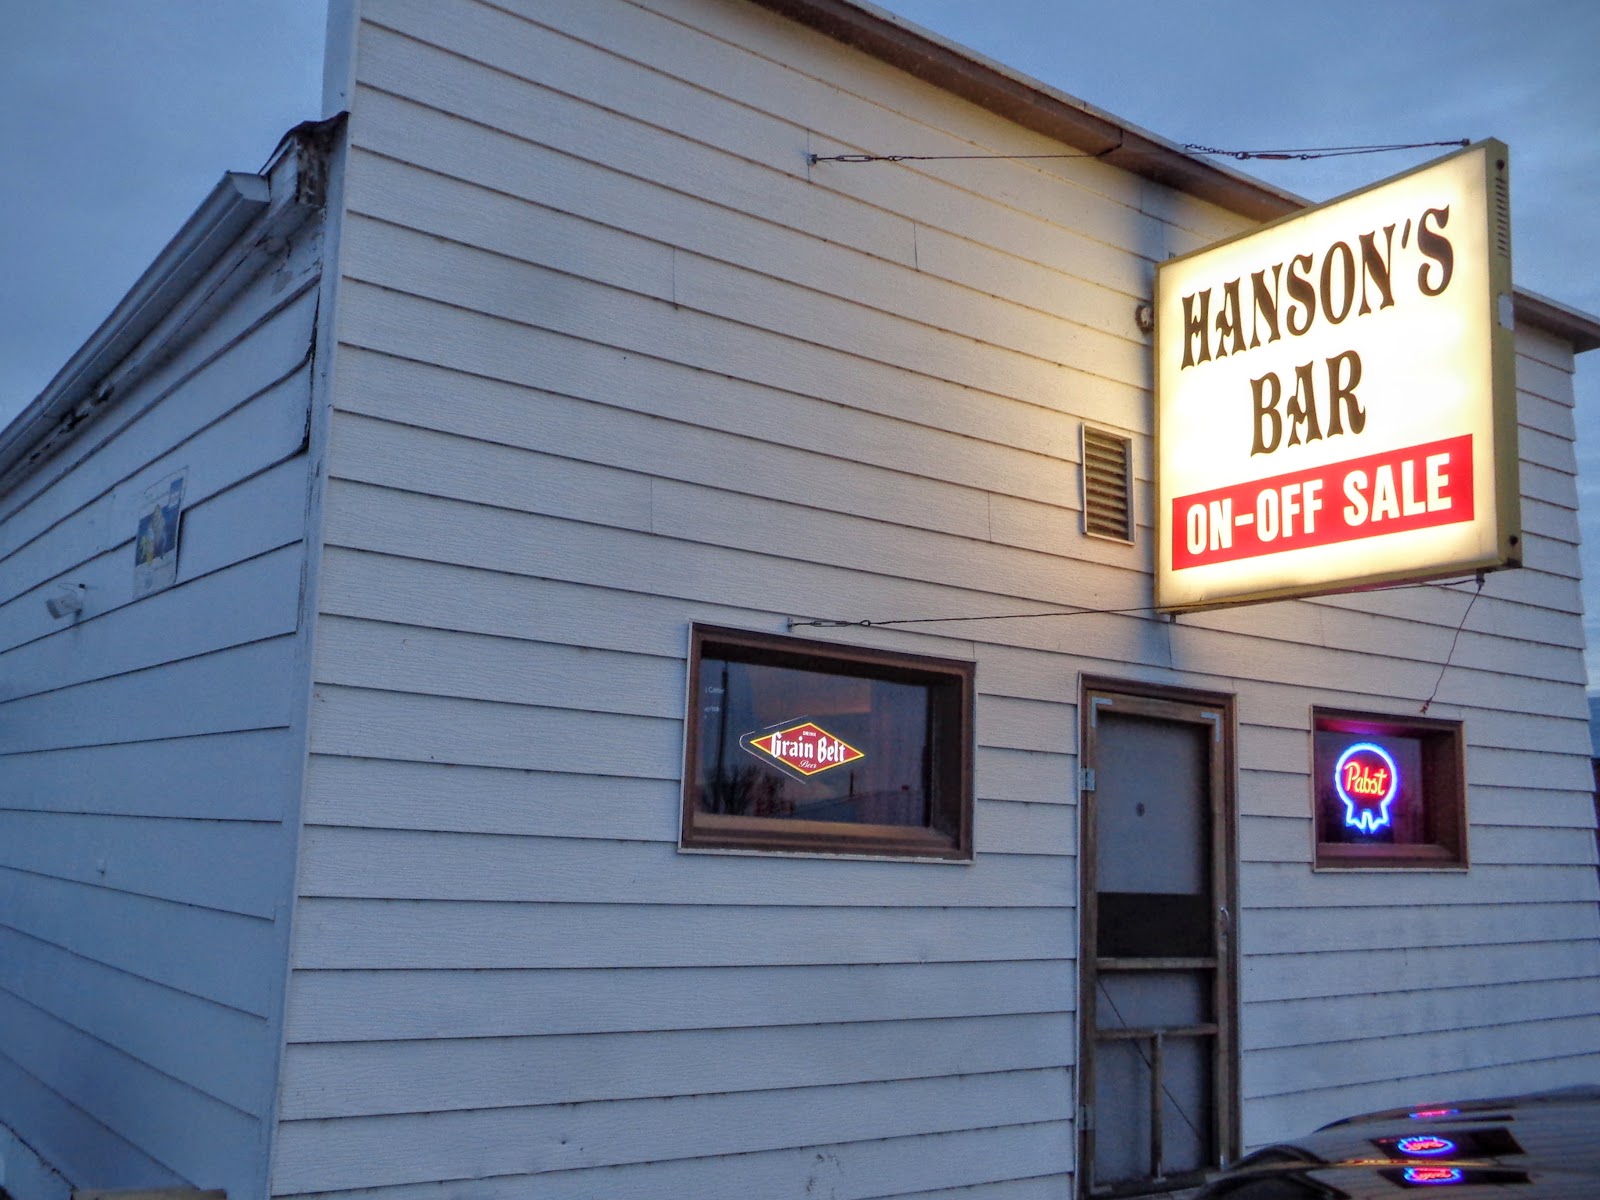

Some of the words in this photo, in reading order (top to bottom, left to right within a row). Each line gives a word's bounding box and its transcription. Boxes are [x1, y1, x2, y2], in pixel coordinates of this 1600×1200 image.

[1181, 204, 1454, 370] HANSON'S
[1250, 350, 1366, 457] BAR
[1186, 479, 1323, 555] ON-OFF
[1343, 453, 1452, 527] SALE
[770, 731, 814, 759] Grain
[817, 736, 846, 764] Belt
[799, 760, 817, 769] Beer
[1343, 761, 1388, 796] Pabst
